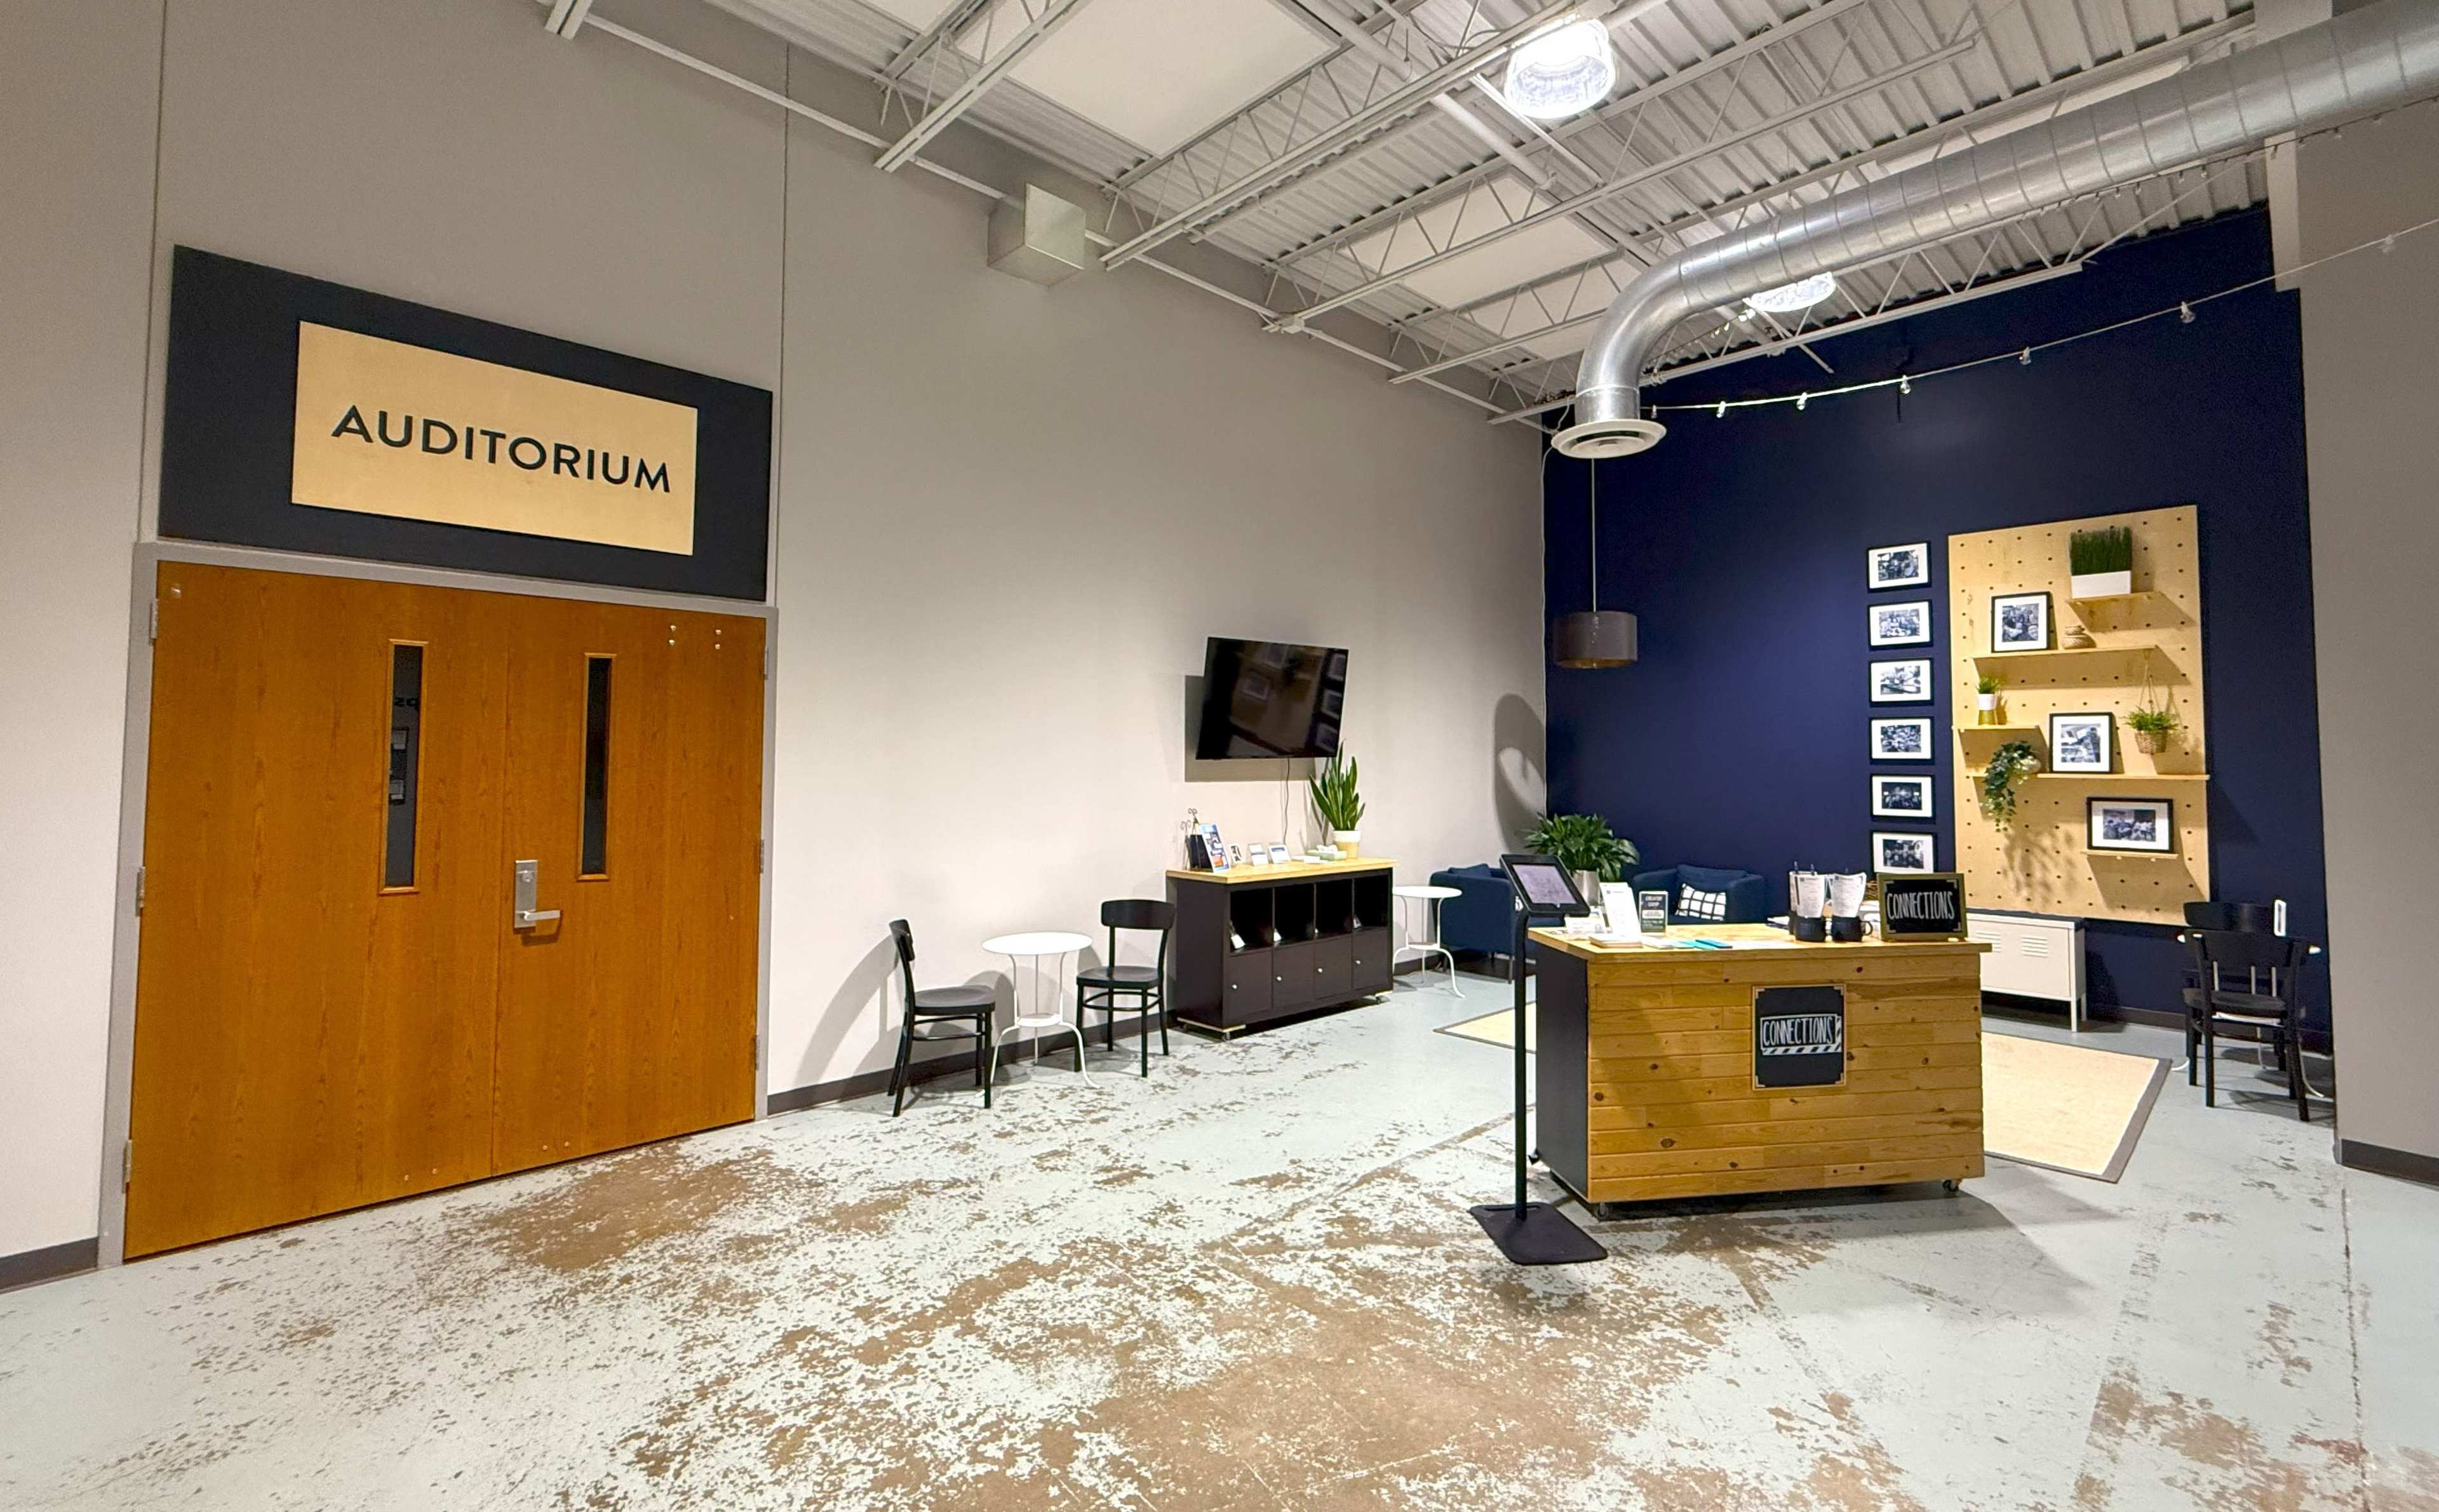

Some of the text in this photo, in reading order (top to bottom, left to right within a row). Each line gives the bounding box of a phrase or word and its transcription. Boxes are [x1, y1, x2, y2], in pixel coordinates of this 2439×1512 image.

[331, 405, 671, 493] AUDITORIUM
[1886, 891, 1955, 920] CONNECTIONS
[1763, 1017, 1833, 1046] CONNECTIONS
